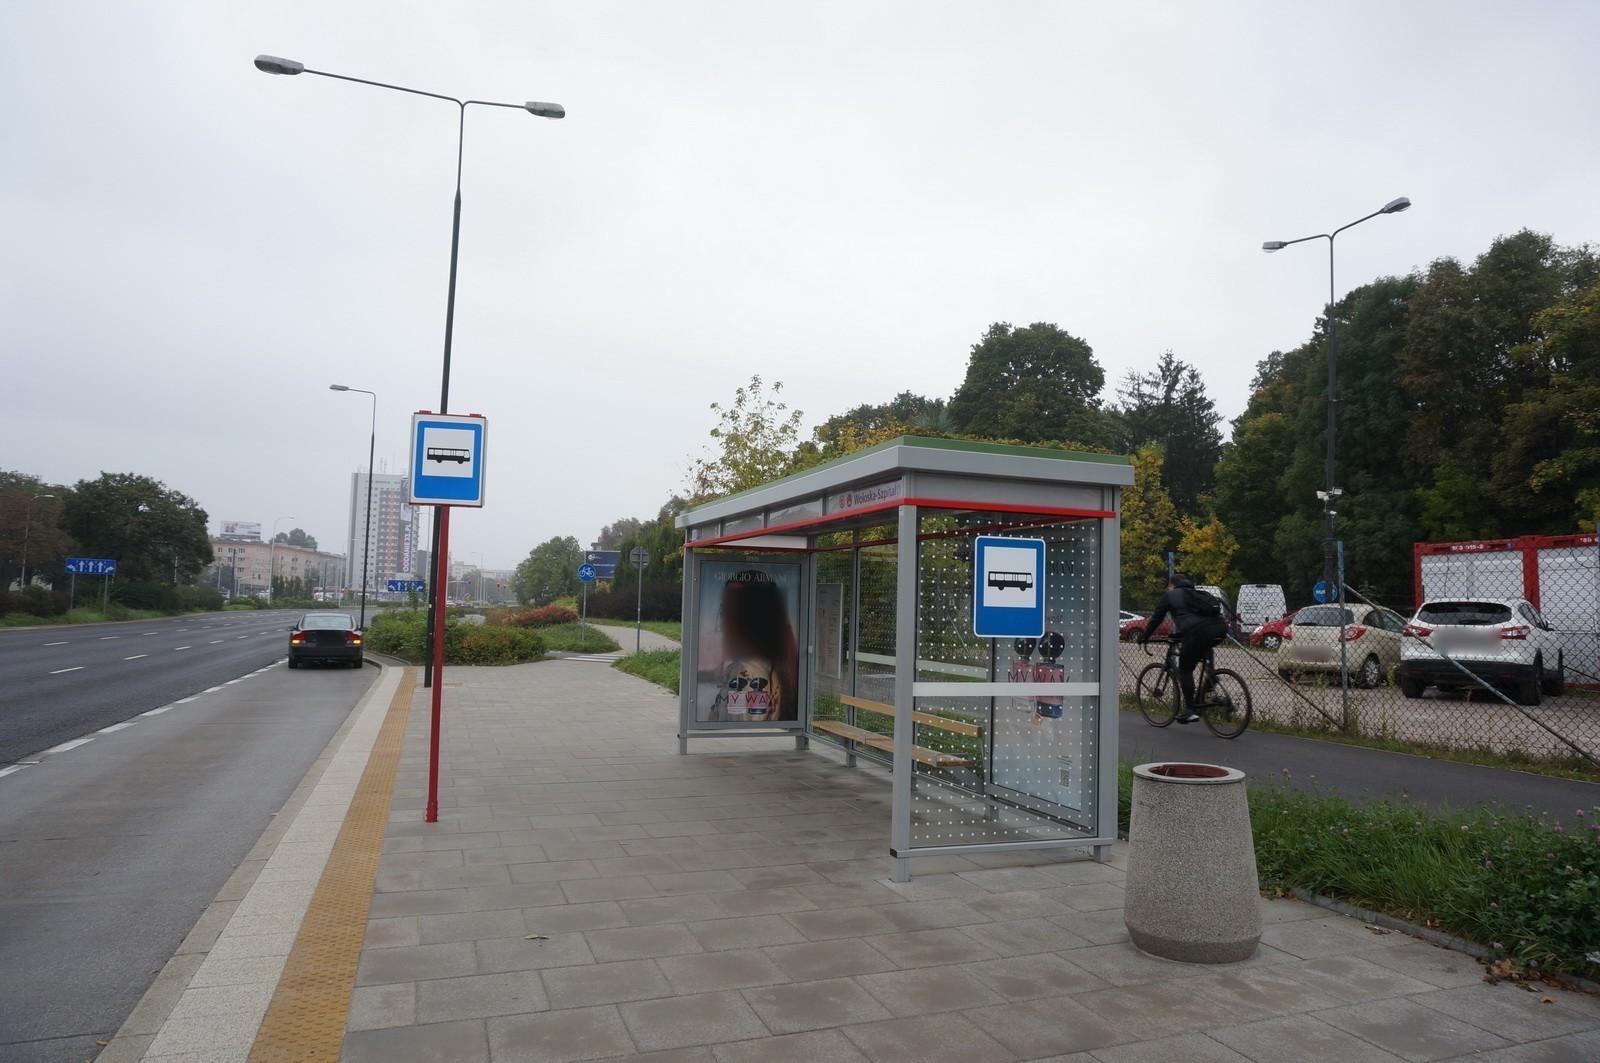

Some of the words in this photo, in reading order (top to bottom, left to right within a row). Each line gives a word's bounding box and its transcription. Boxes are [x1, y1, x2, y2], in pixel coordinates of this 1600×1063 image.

[714, 571, 751, 582] GIORGIO
[717, 694, 740, 704] MY
[745, 694, 775, 704] WAY
